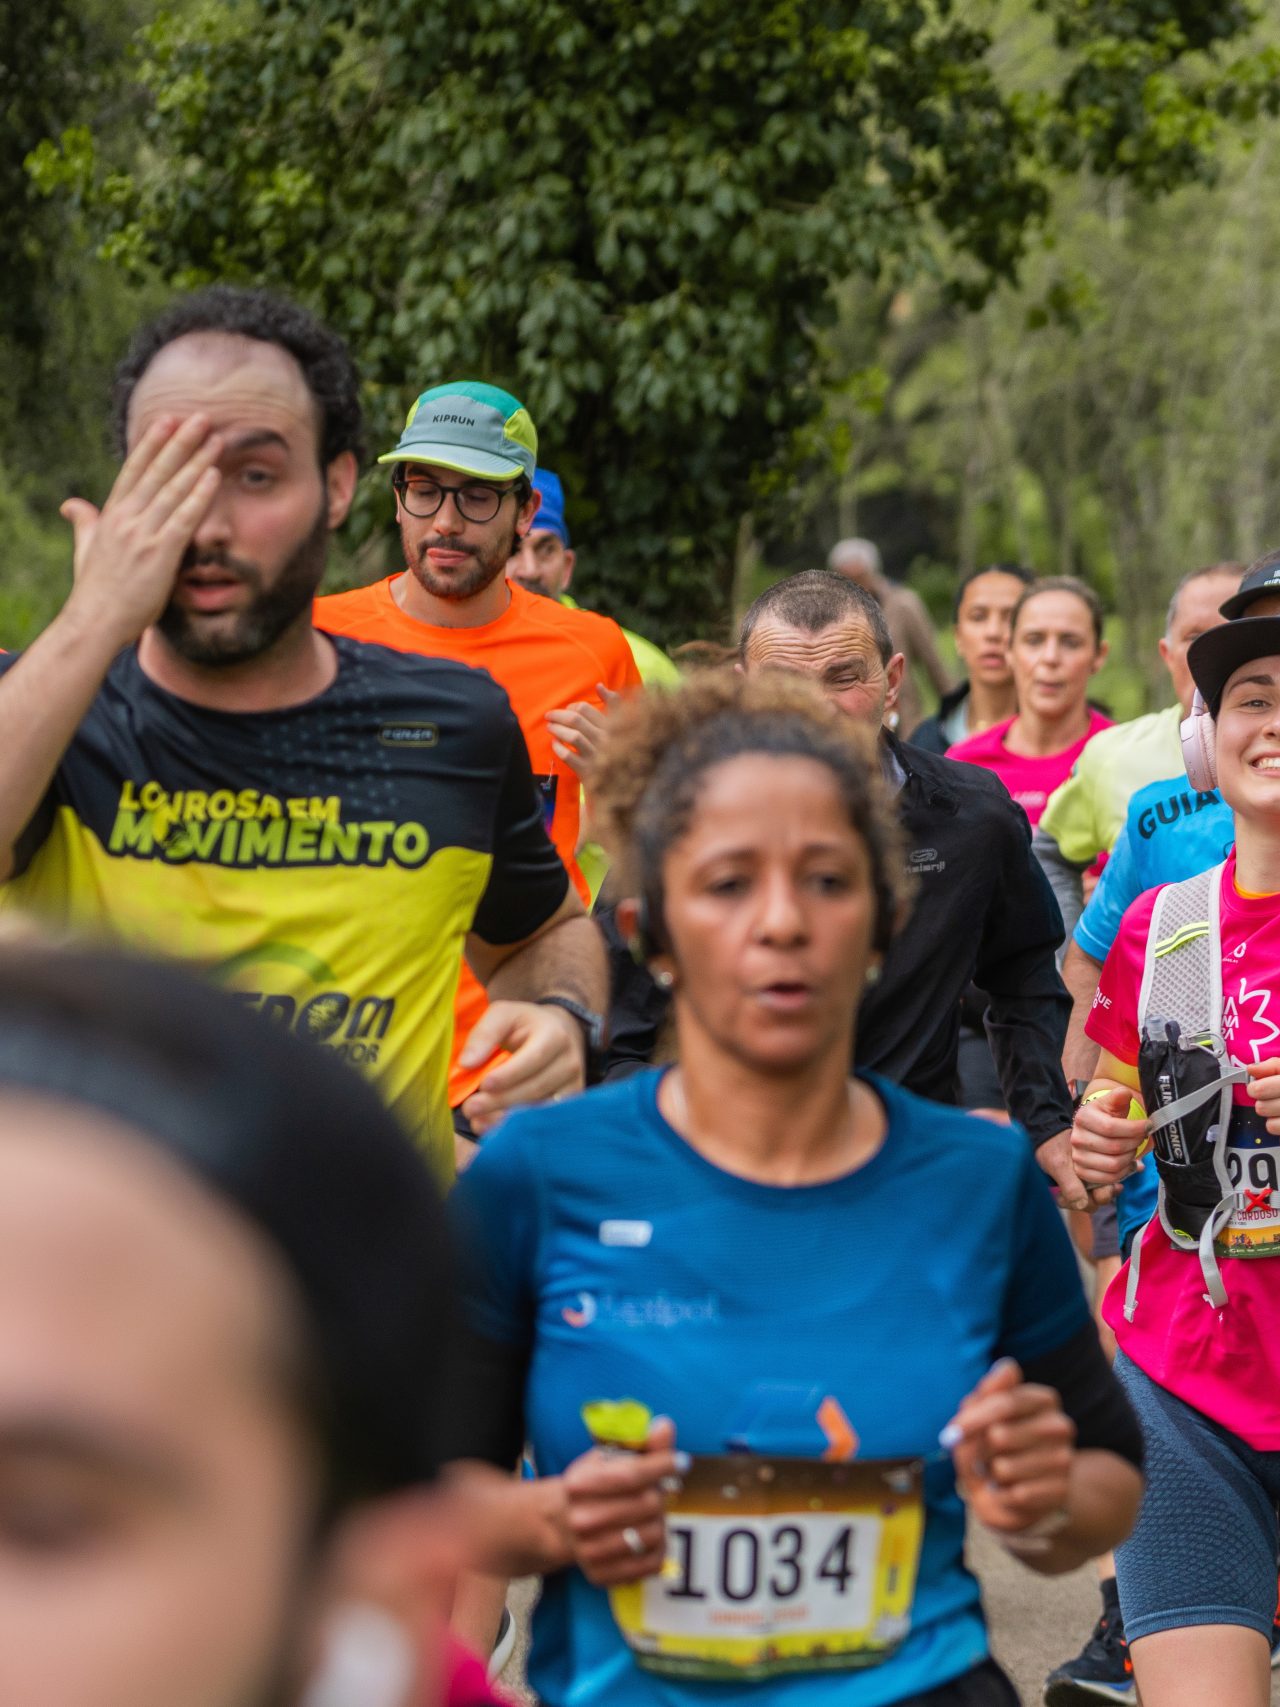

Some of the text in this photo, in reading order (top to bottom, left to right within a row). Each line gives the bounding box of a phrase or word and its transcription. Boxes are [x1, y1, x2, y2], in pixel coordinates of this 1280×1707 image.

[432, 414, 476, 427] KIPRUN
[285, 796, 341, 824] EM
[1137, 790, 1220, 840] GUIA
[664, 1525, 855, 1602] 1034
